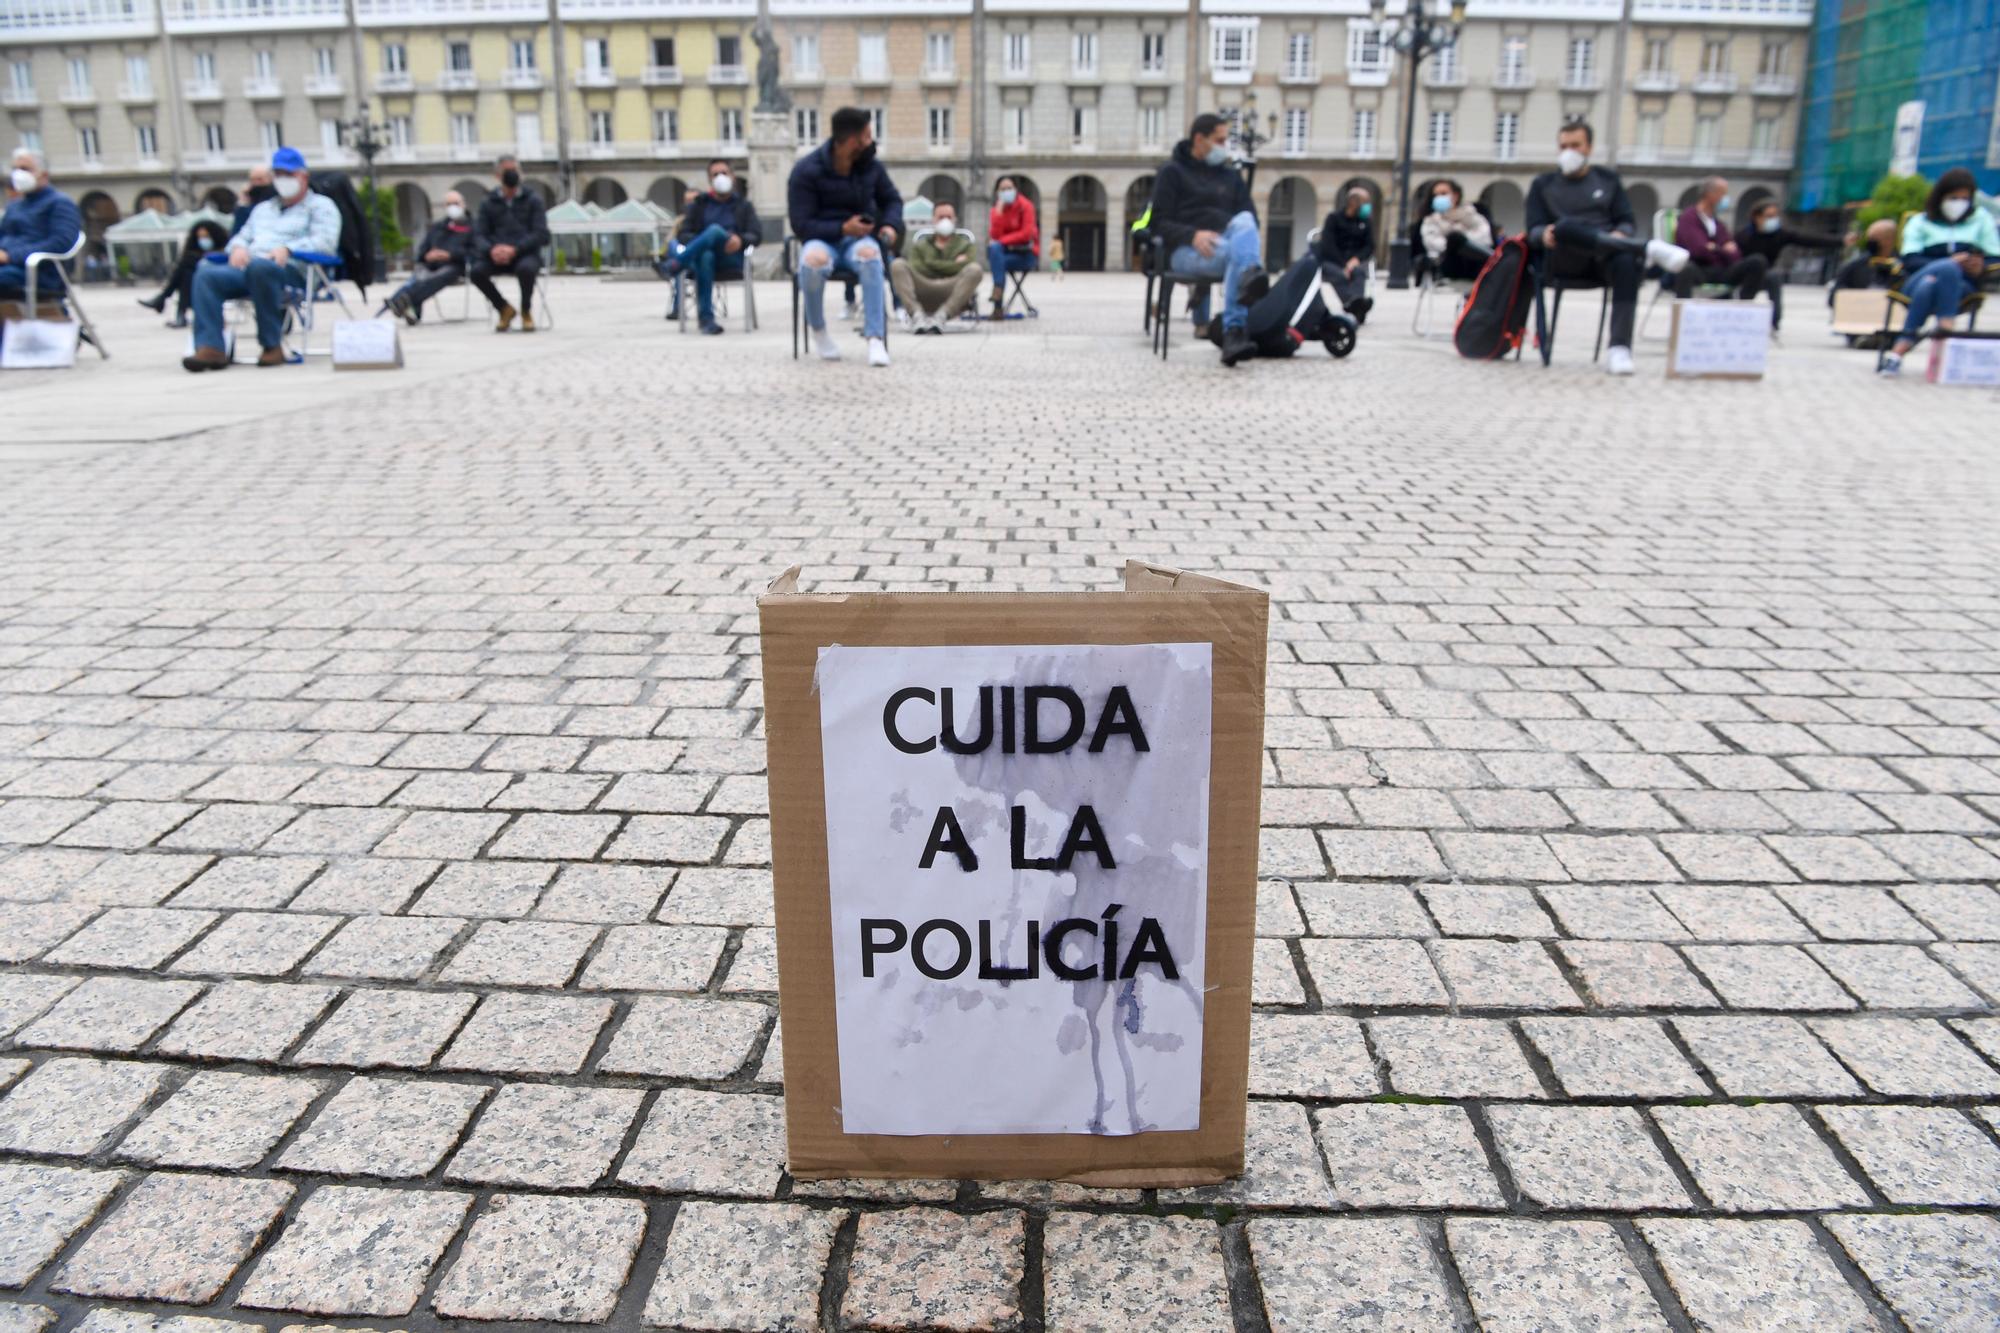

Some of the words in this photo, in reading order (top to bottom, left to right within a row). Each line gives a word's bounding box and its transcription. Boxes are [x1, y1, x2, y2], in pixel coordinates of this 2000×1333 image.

[883, 685, 1151, 755] CUIDA
[918, 805, 978, 873] A
[1010, 804, 1117, 872] LA
[860, 903, 1180, 982] POLICÍA
